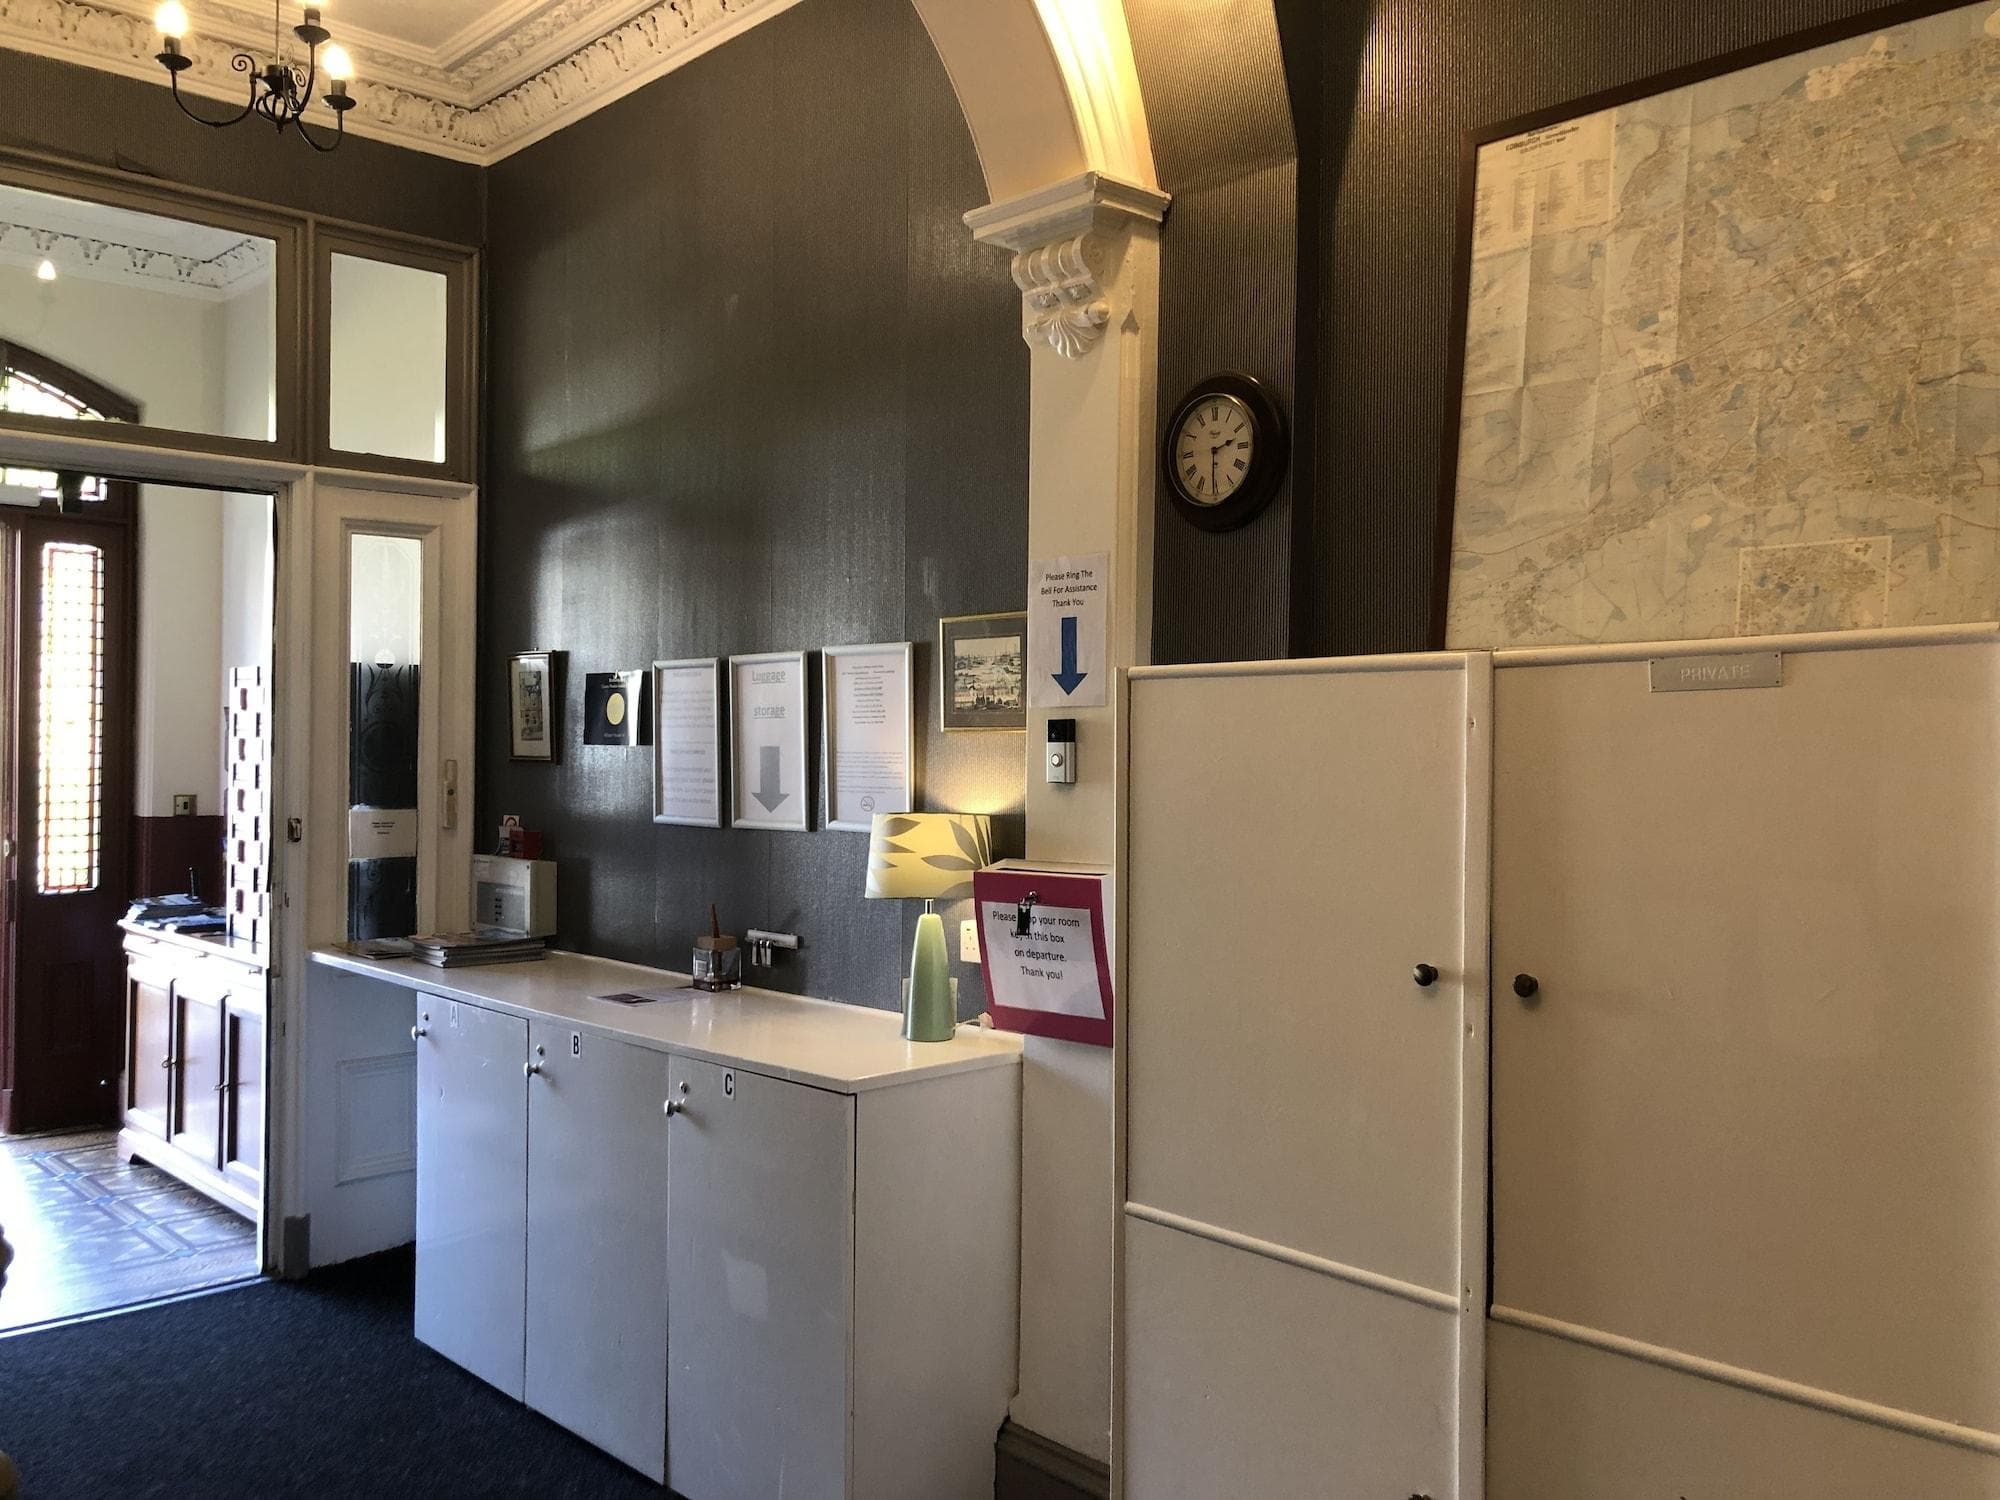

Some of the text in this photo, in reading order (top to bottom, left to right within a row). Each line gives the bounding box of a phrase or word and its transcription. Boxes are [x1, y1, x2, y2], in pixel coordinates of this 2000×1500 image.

[1045, 569, 1093, 581] Please Ring The
[1041, 585, 1097, 595] Bell For Assistance
[1052, 598, 1084, 607] Thank You
[1681, 664, 1752, 681] PRIVATE
[992, 911, 1017, 922] Please
[1038, 917, 1056, 926] your
[1058, 918, 1080, 927] room
[1034, 931, 1049, 942] this
[1050, 933, 1065, 943] box
[1014, 948, 1067, 962] on departure.
[1020, 966, 1064, 980] Thank you!
[573, 1034, 579, 1055] B
[725, 1073, 733, 1095] C
